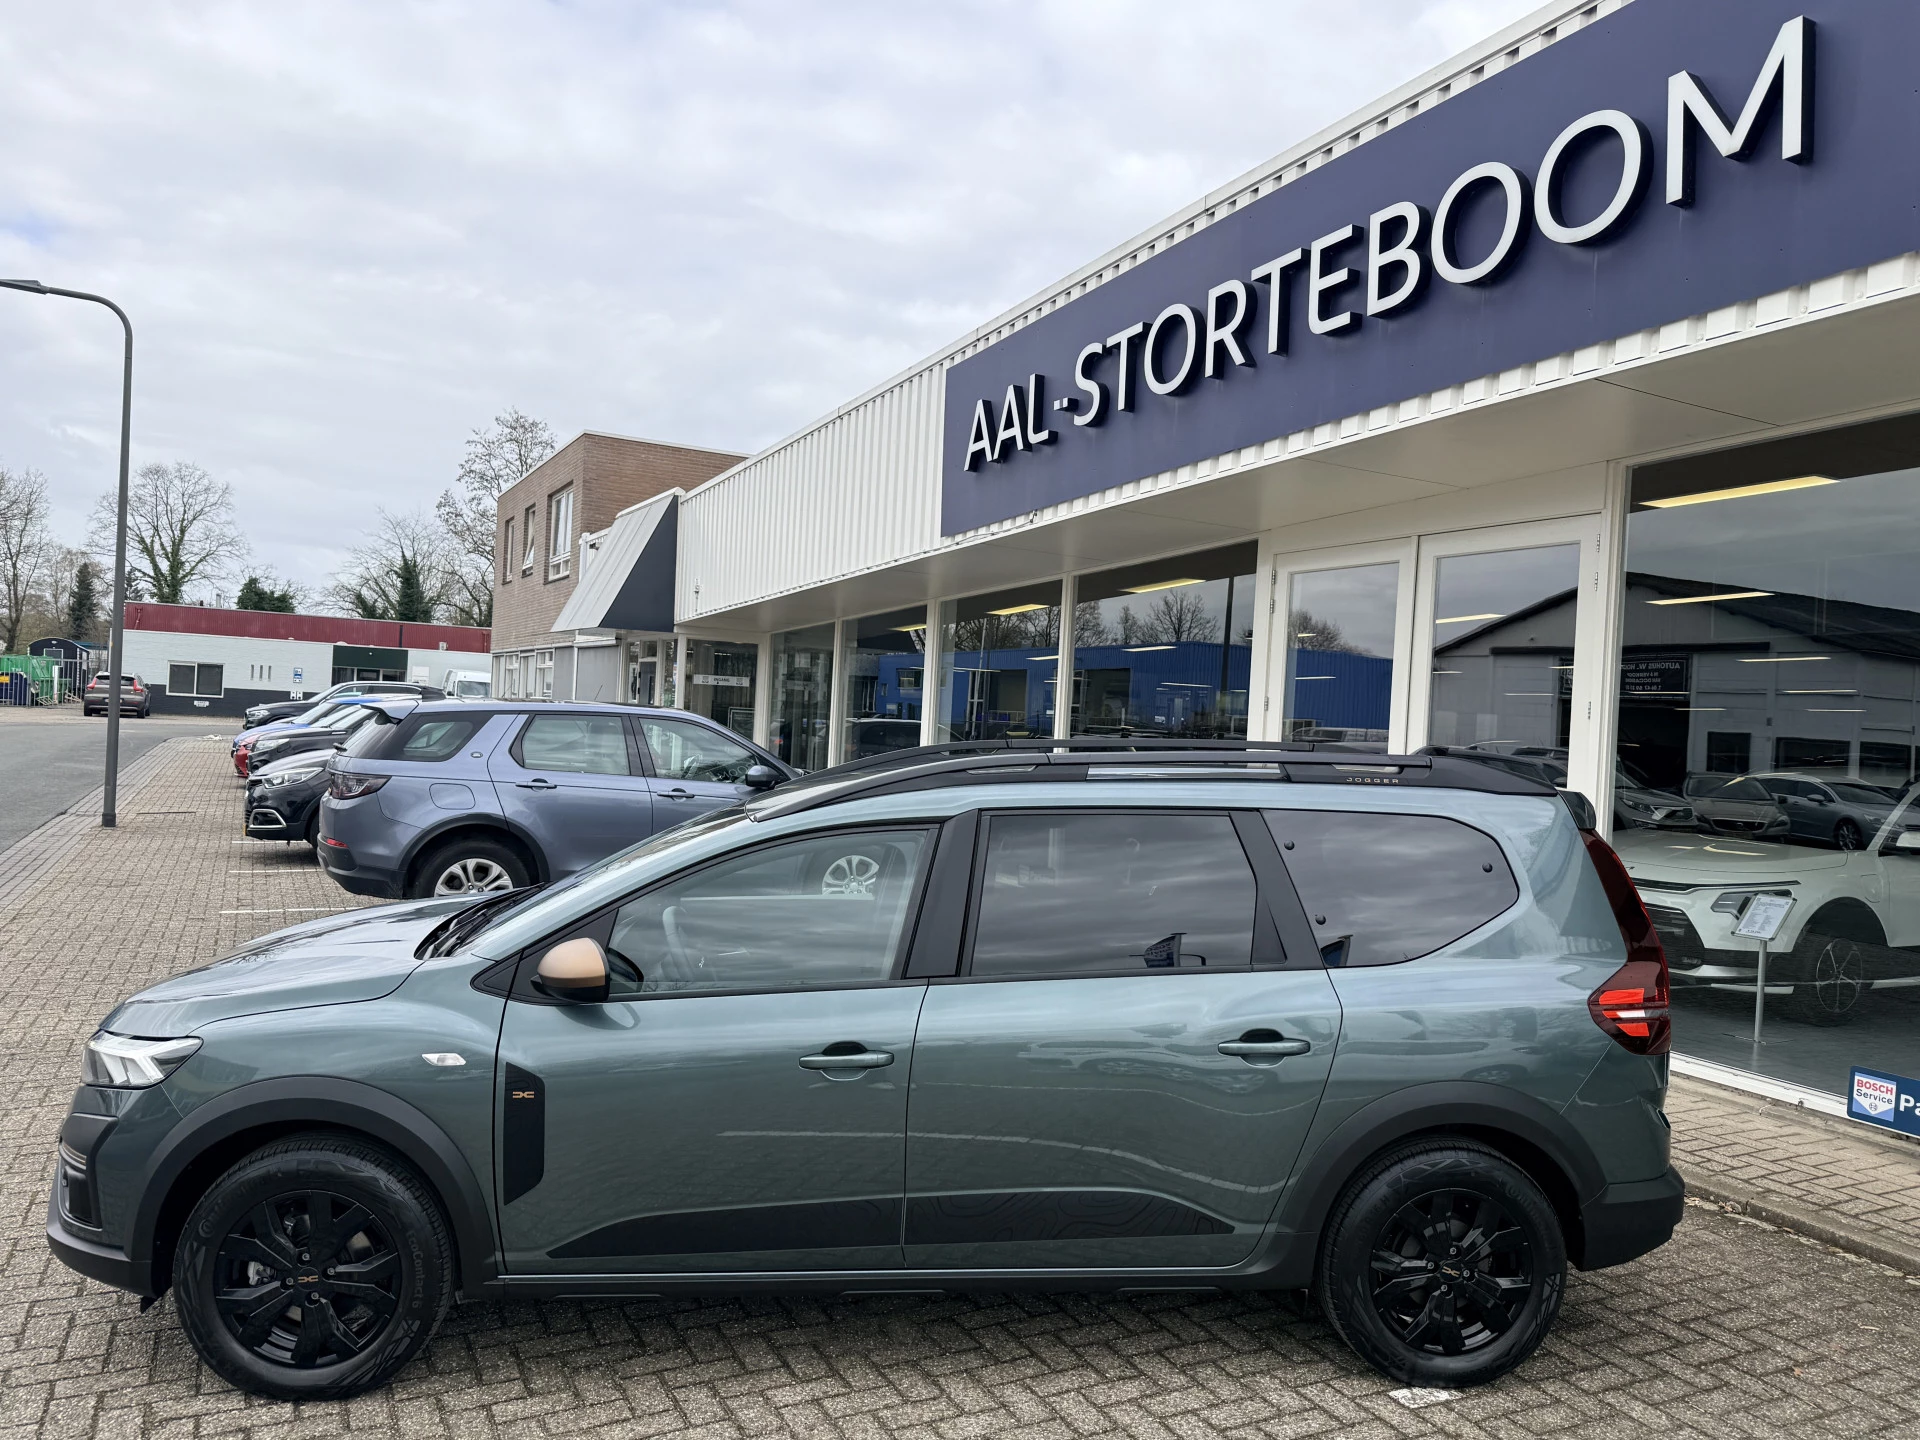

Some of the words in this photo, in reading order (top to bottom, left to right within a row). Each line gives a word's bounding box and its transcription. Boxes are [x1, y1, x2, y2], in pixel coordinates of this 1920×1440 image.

[963, 14, 1812, 473] AAL-STORTEBOOM
[1855, 1088, 1893, 1104] Service
[1856, 1079, 1894, 1095] BOSCH
[406, 1229, 425, 1298] EcoContact
